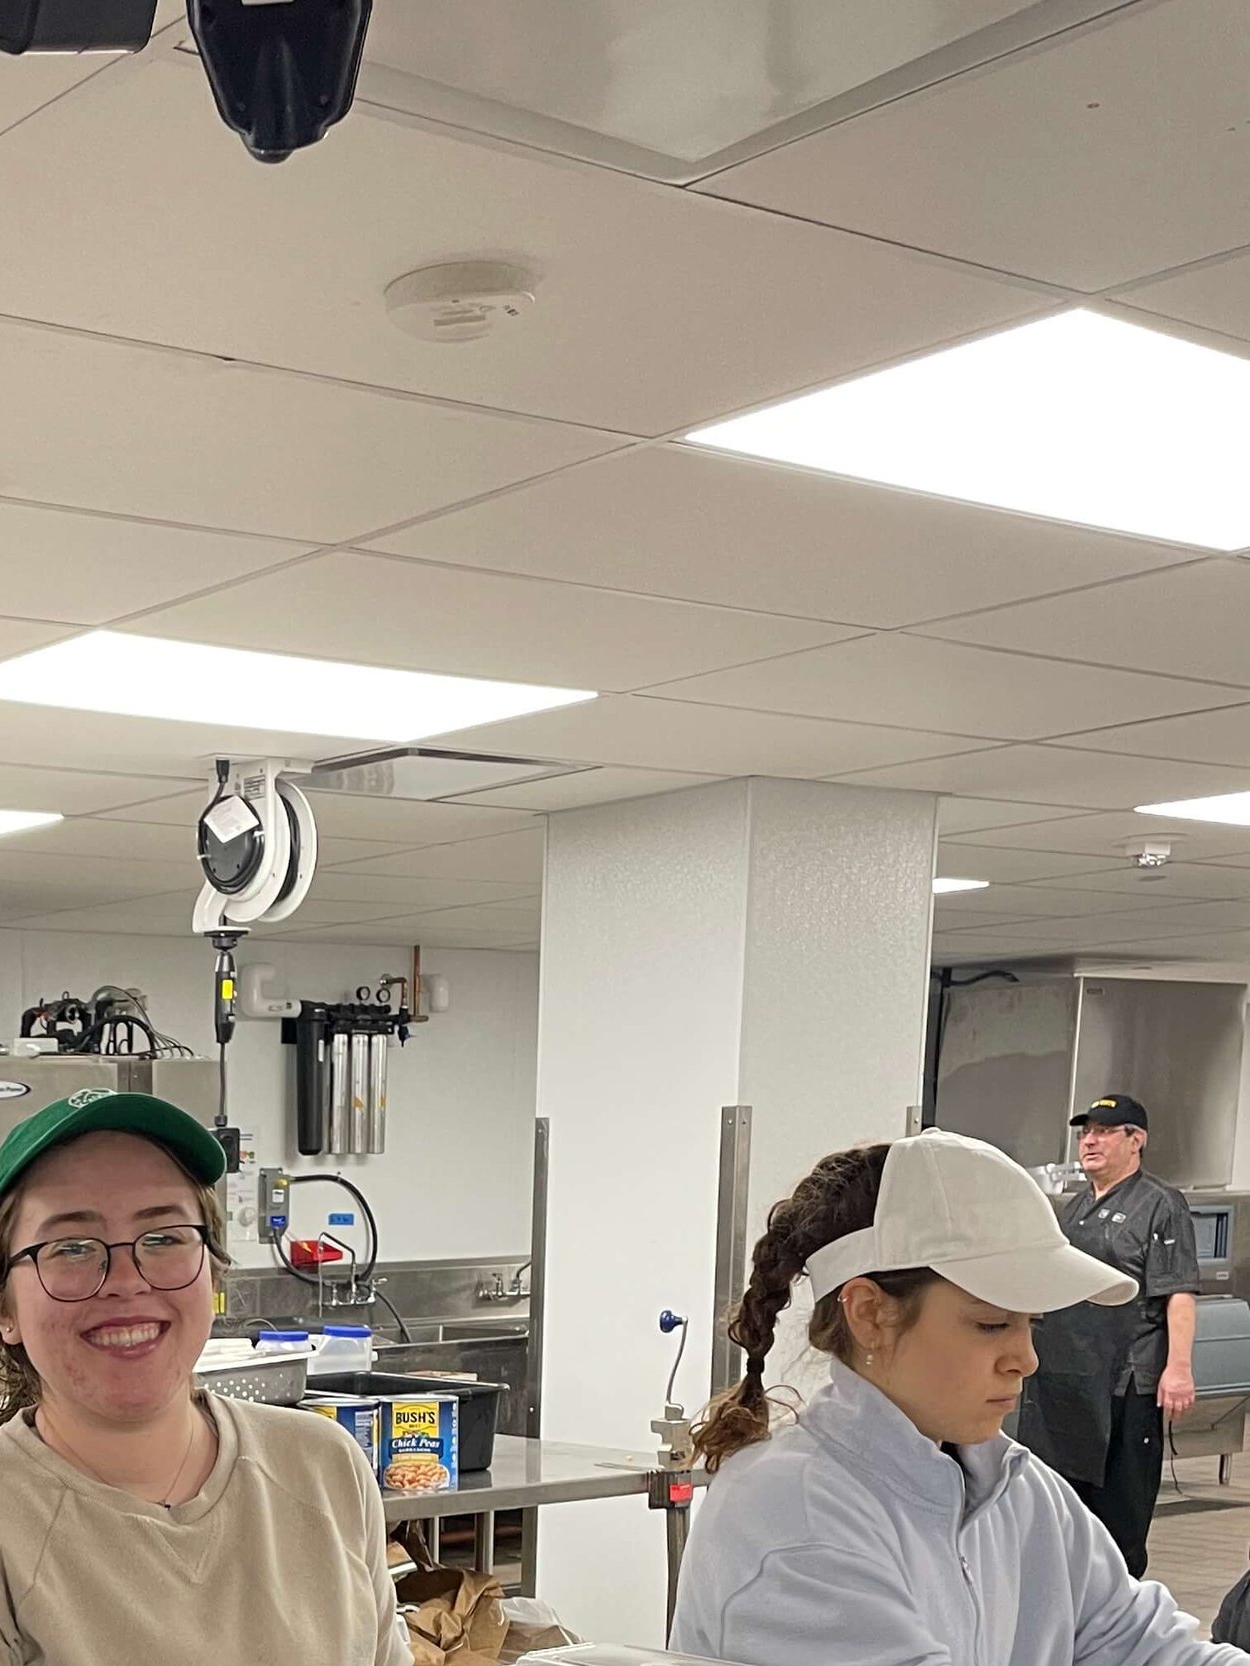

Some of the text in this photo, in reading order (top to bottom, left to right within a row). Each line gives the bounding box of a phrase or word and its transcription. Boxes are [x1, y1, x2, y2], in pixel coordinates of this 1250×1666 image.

[395, 1411, 436, 1424] BUSH'S
[391, 1437, 441, 1449] Chick Peas
